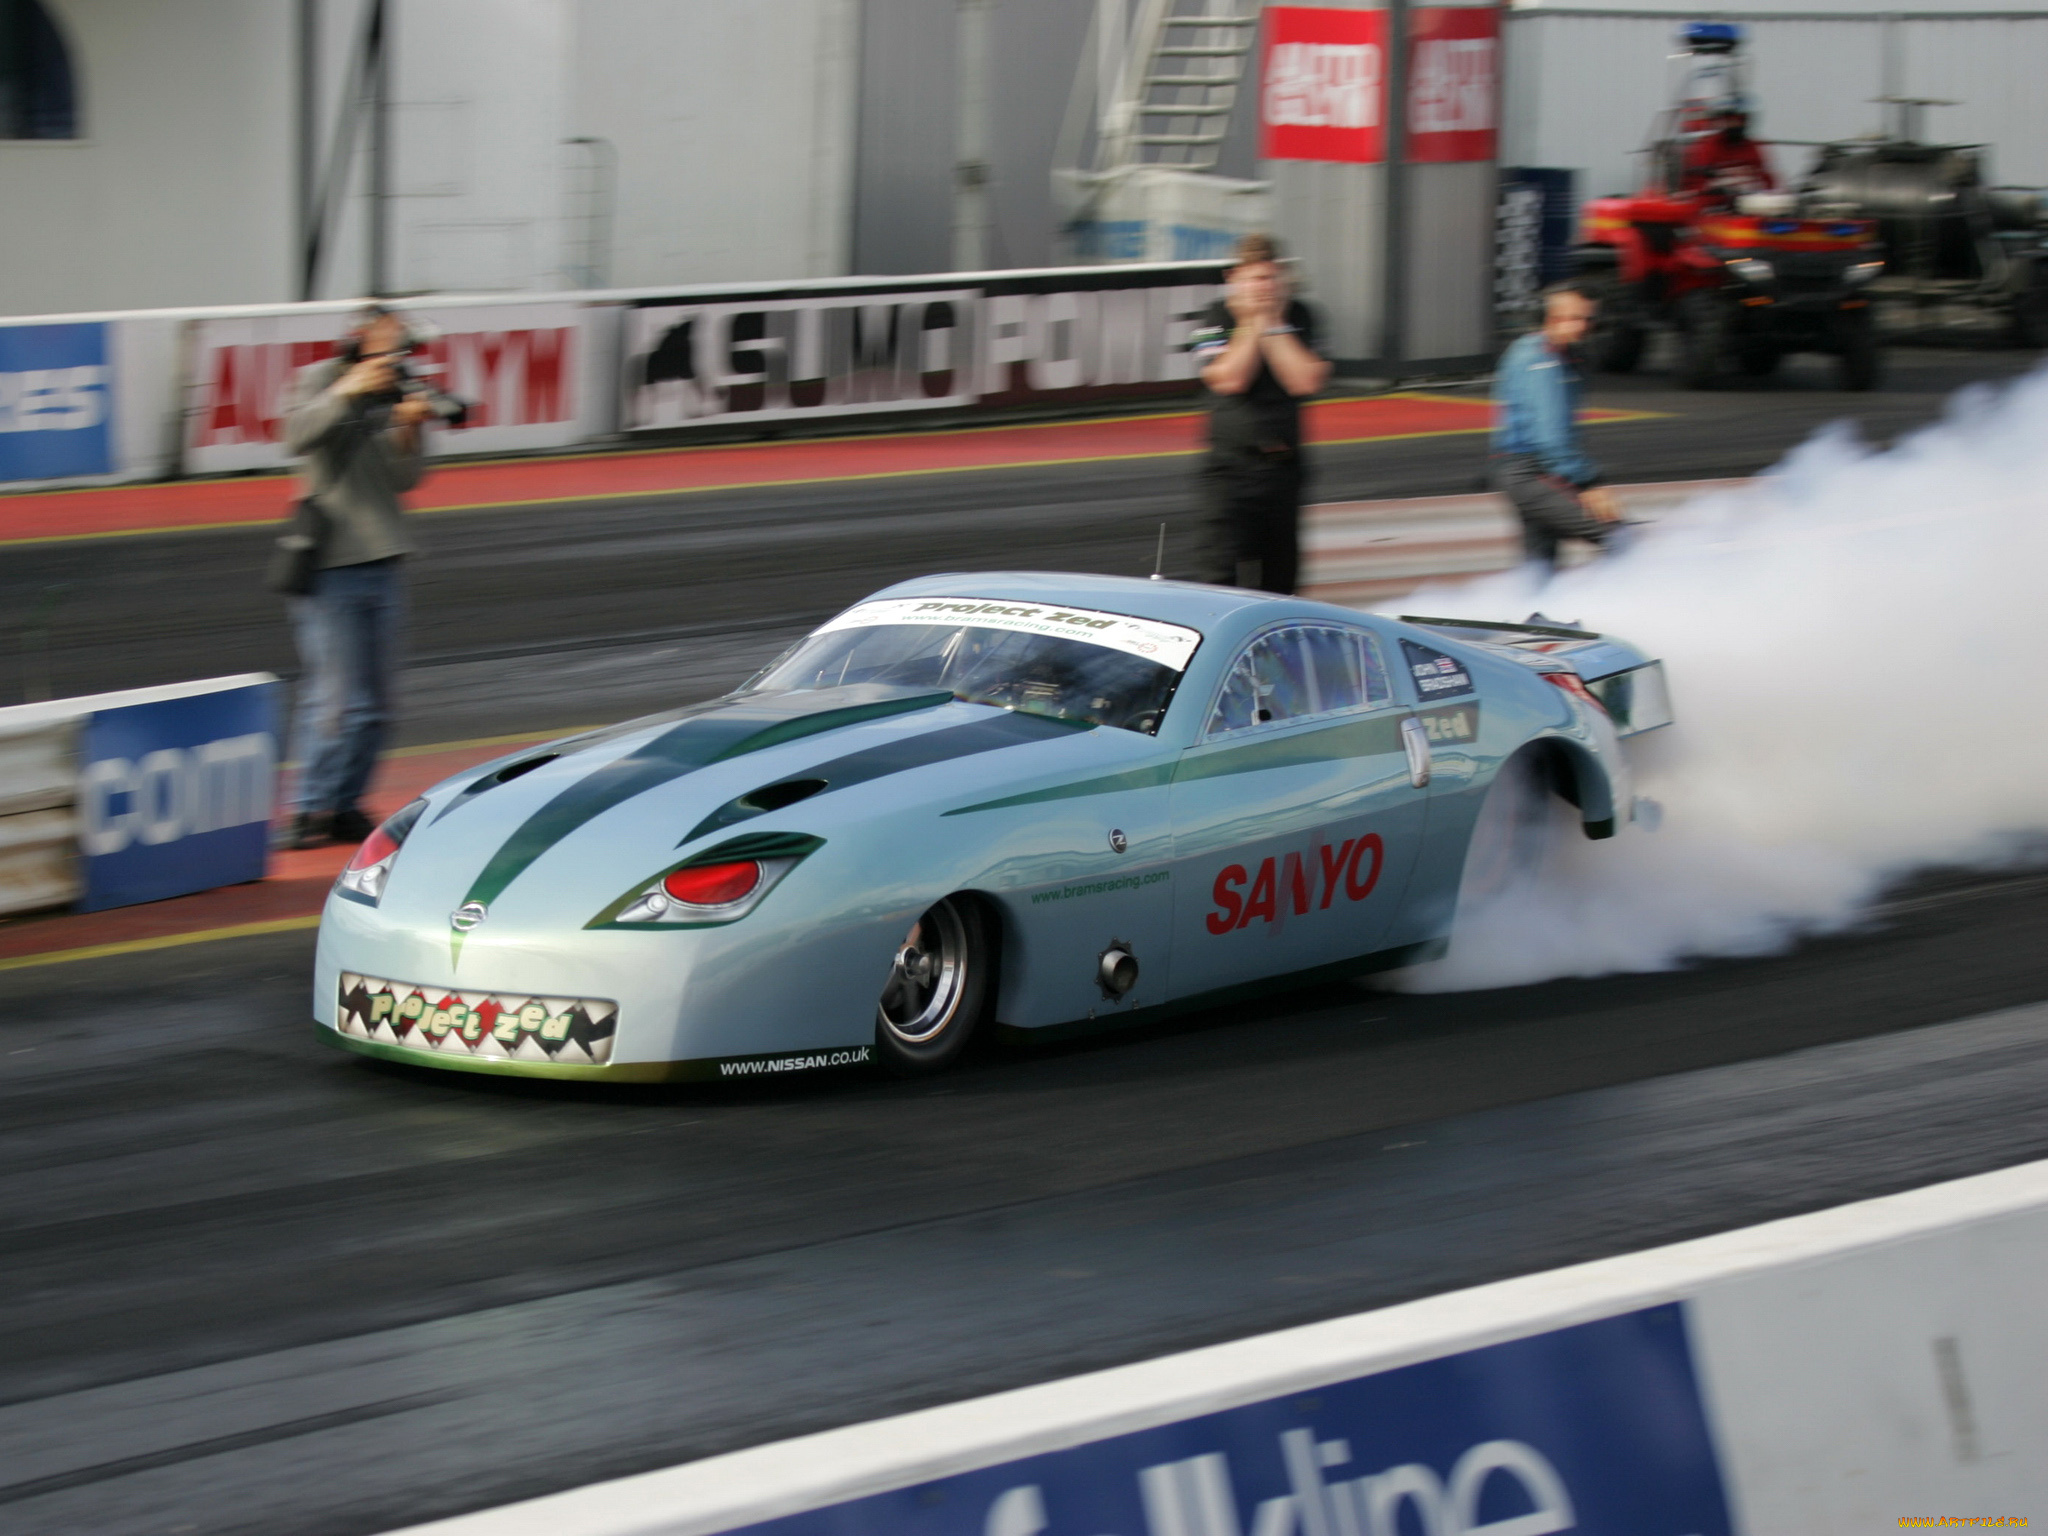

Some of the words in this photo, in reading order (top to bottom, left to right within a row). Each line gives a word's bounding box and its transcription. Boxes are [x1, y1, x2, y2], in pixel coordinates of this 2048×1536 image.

[901, 613, 1094, 639] www.bramsracing.com
[80, 731, 275, 857] com
[1031, 870, 1170, 905] www.bramsracing.com
[1206, 831, 1384, 938] SANYO
